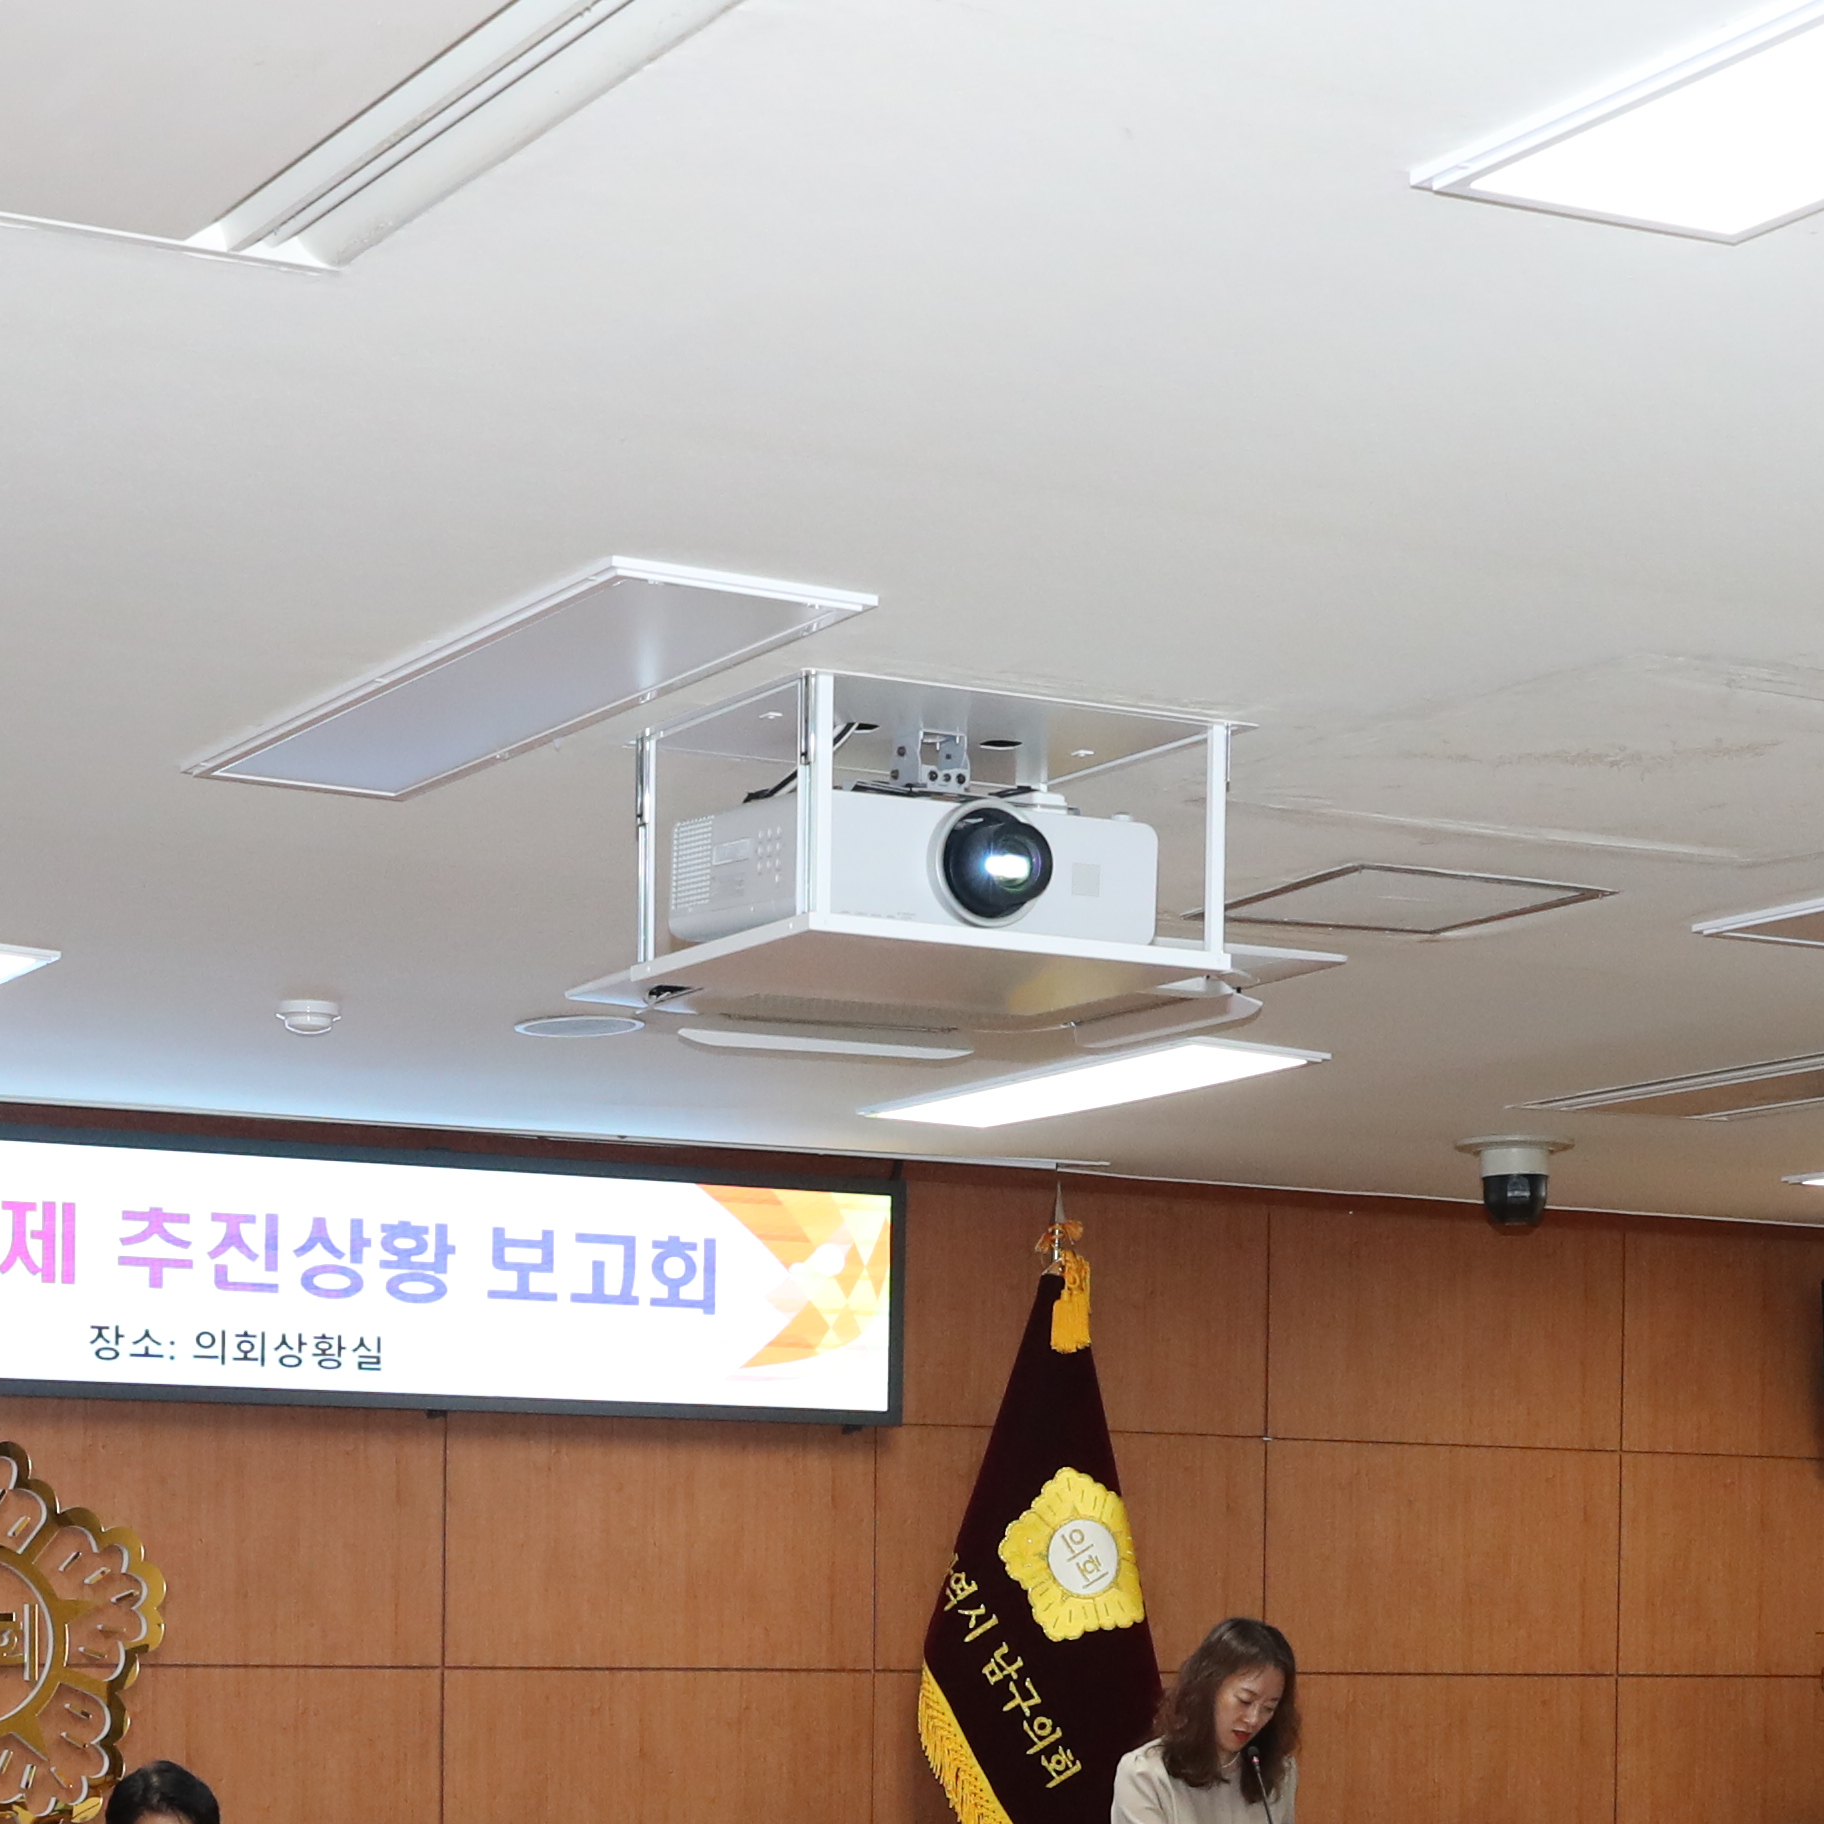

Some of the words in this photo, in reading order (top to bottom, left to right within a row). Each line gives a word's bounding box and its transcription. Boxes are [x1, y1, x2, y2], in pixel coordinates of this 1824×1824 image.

[118, 1207, 455, 1303] 추진상황
[488, 1227, 716, 1315] 보고회
[90, 1325, 175, 1360] 장소:
[193, 1330, 381, 1371] 의회상황실
[1061, 1528, 1109, 1589] 의회
[943, 1553, 999, 1642] 역시
[982, 1641, 1082, 1789] 남구의회
